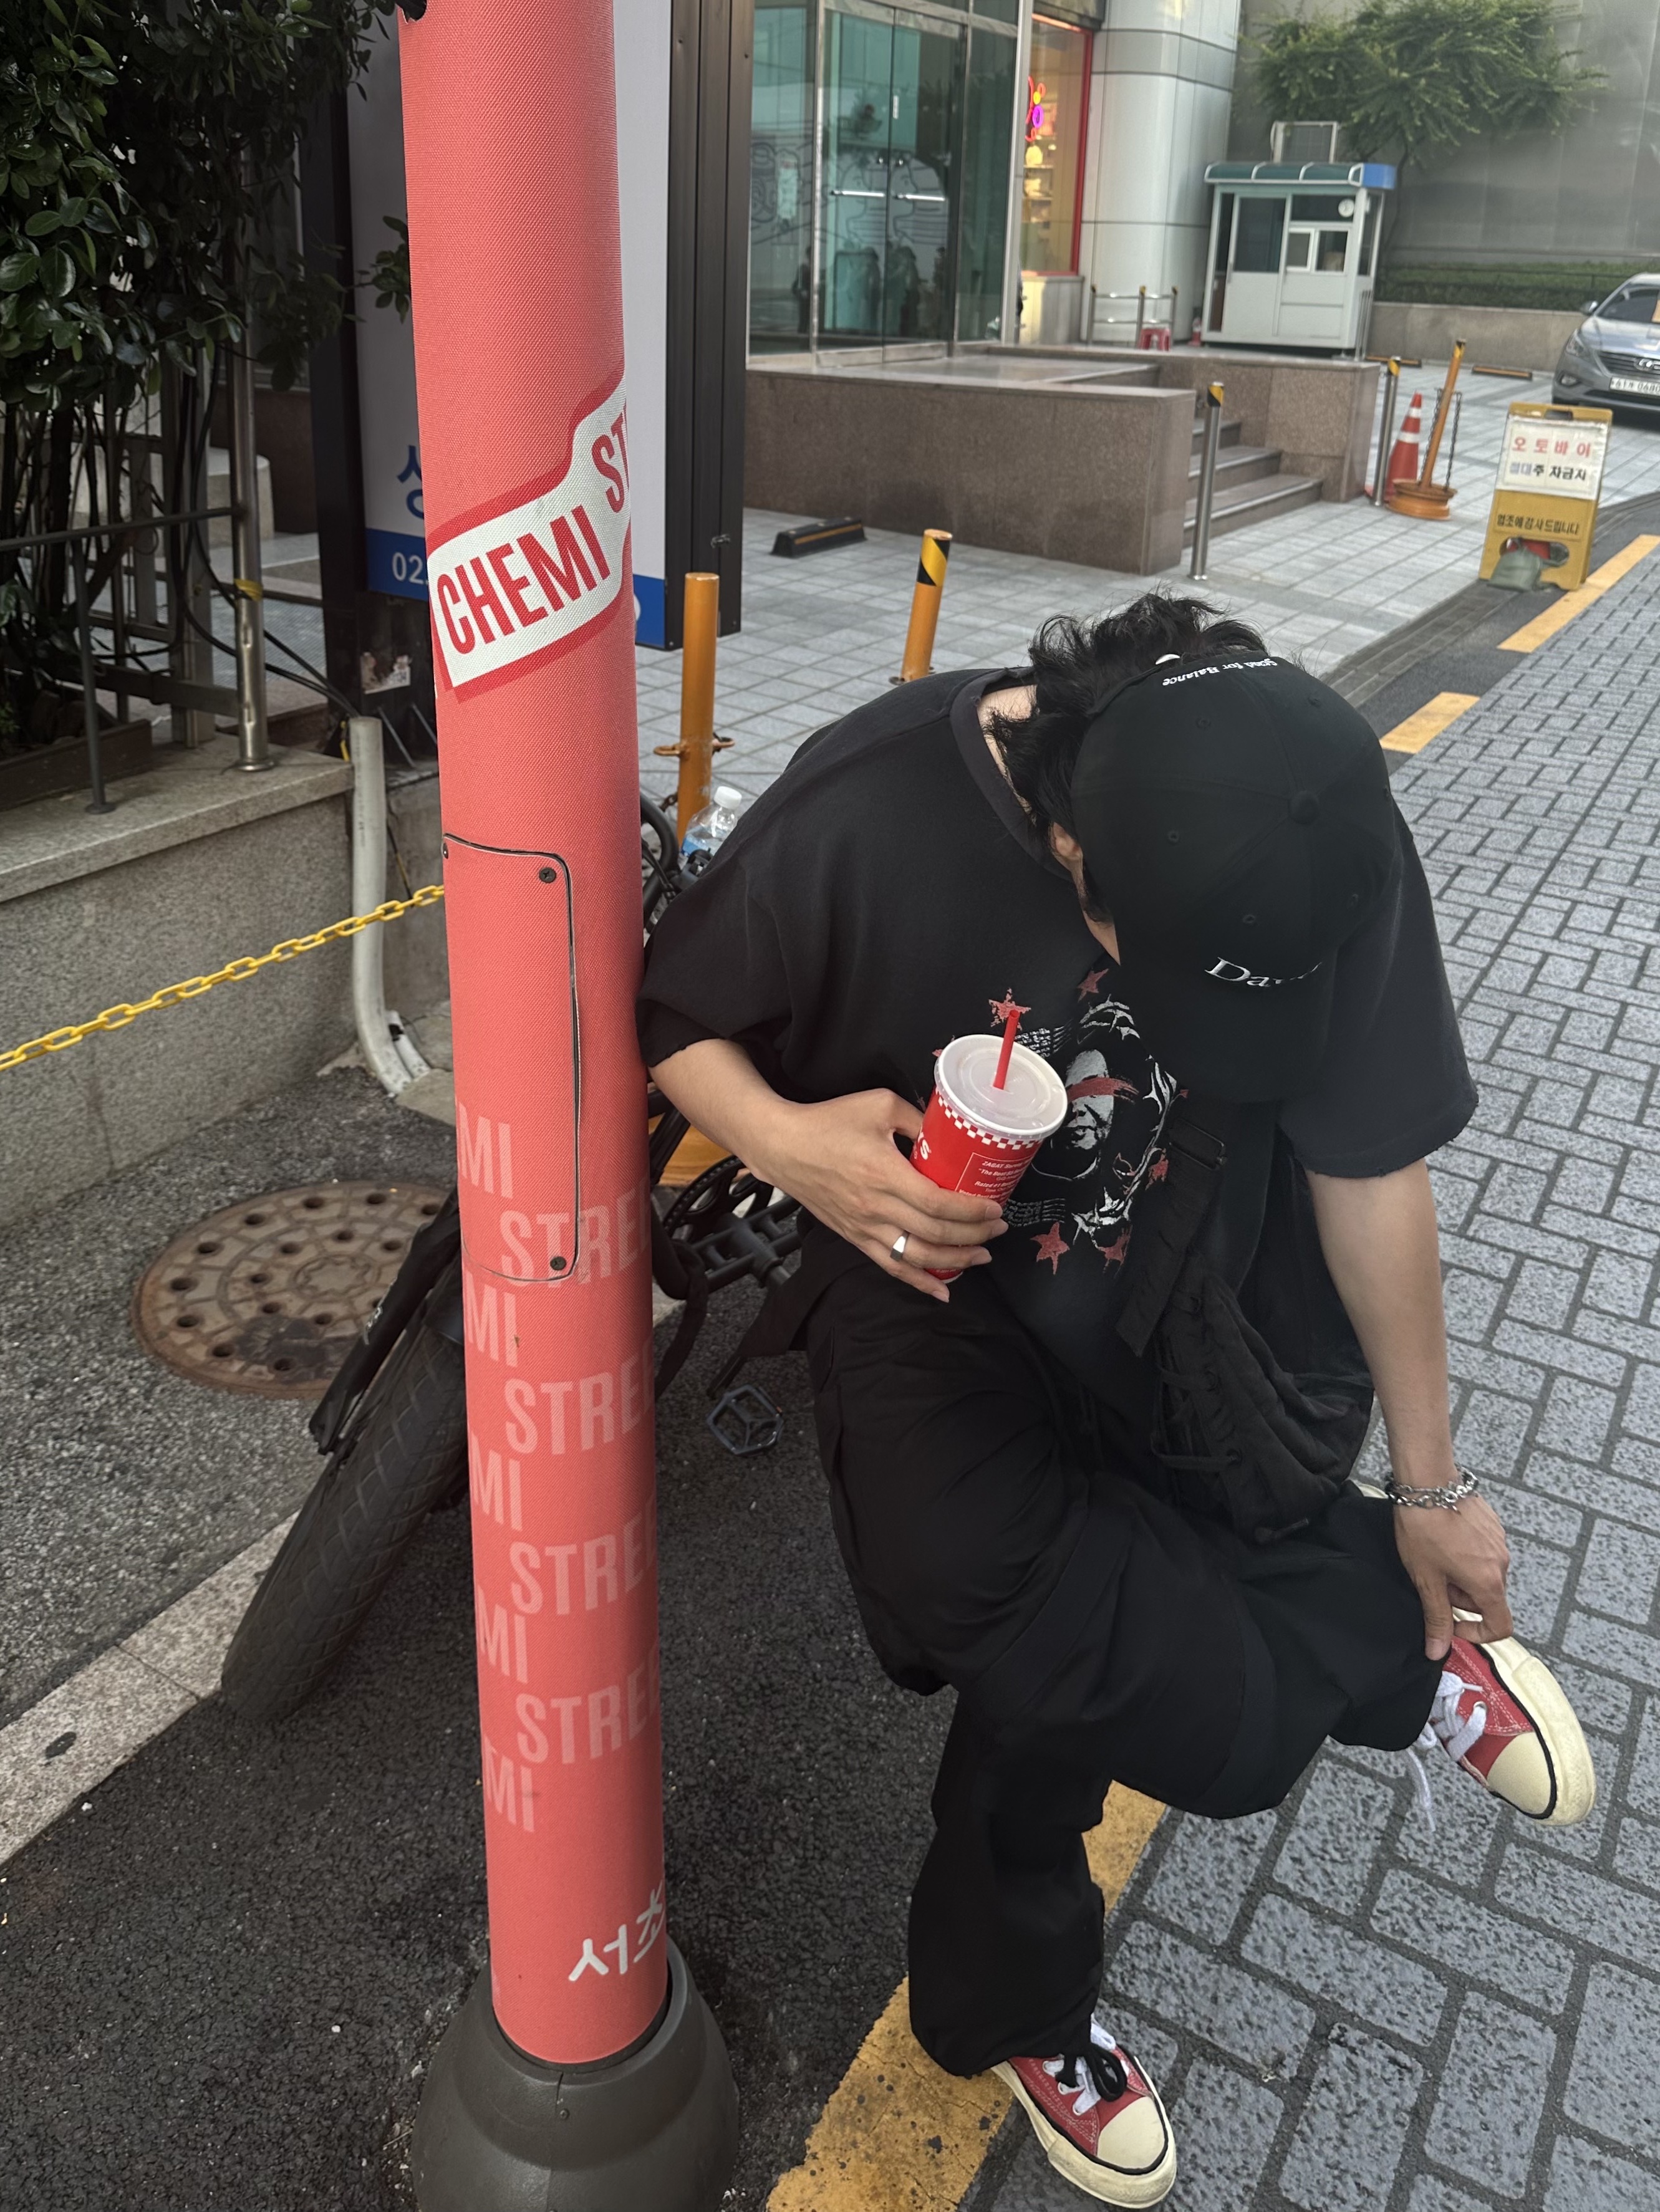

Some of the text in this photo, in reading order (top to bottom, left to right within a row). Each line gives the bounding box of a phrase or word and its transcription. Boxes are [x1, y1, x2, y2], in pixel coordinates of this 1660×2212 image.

[437, 505, 610, 655] CHEMI
[1162, 666, 1220, 686] Balance
[459, 1102, 513, 1200] MI
[466, 1271, 518, 1367] MI
[471, 1430, 523, 1531] MI
[478, 1584, 528, 1684] MI
[484, 1734, 535, 1833] MI
